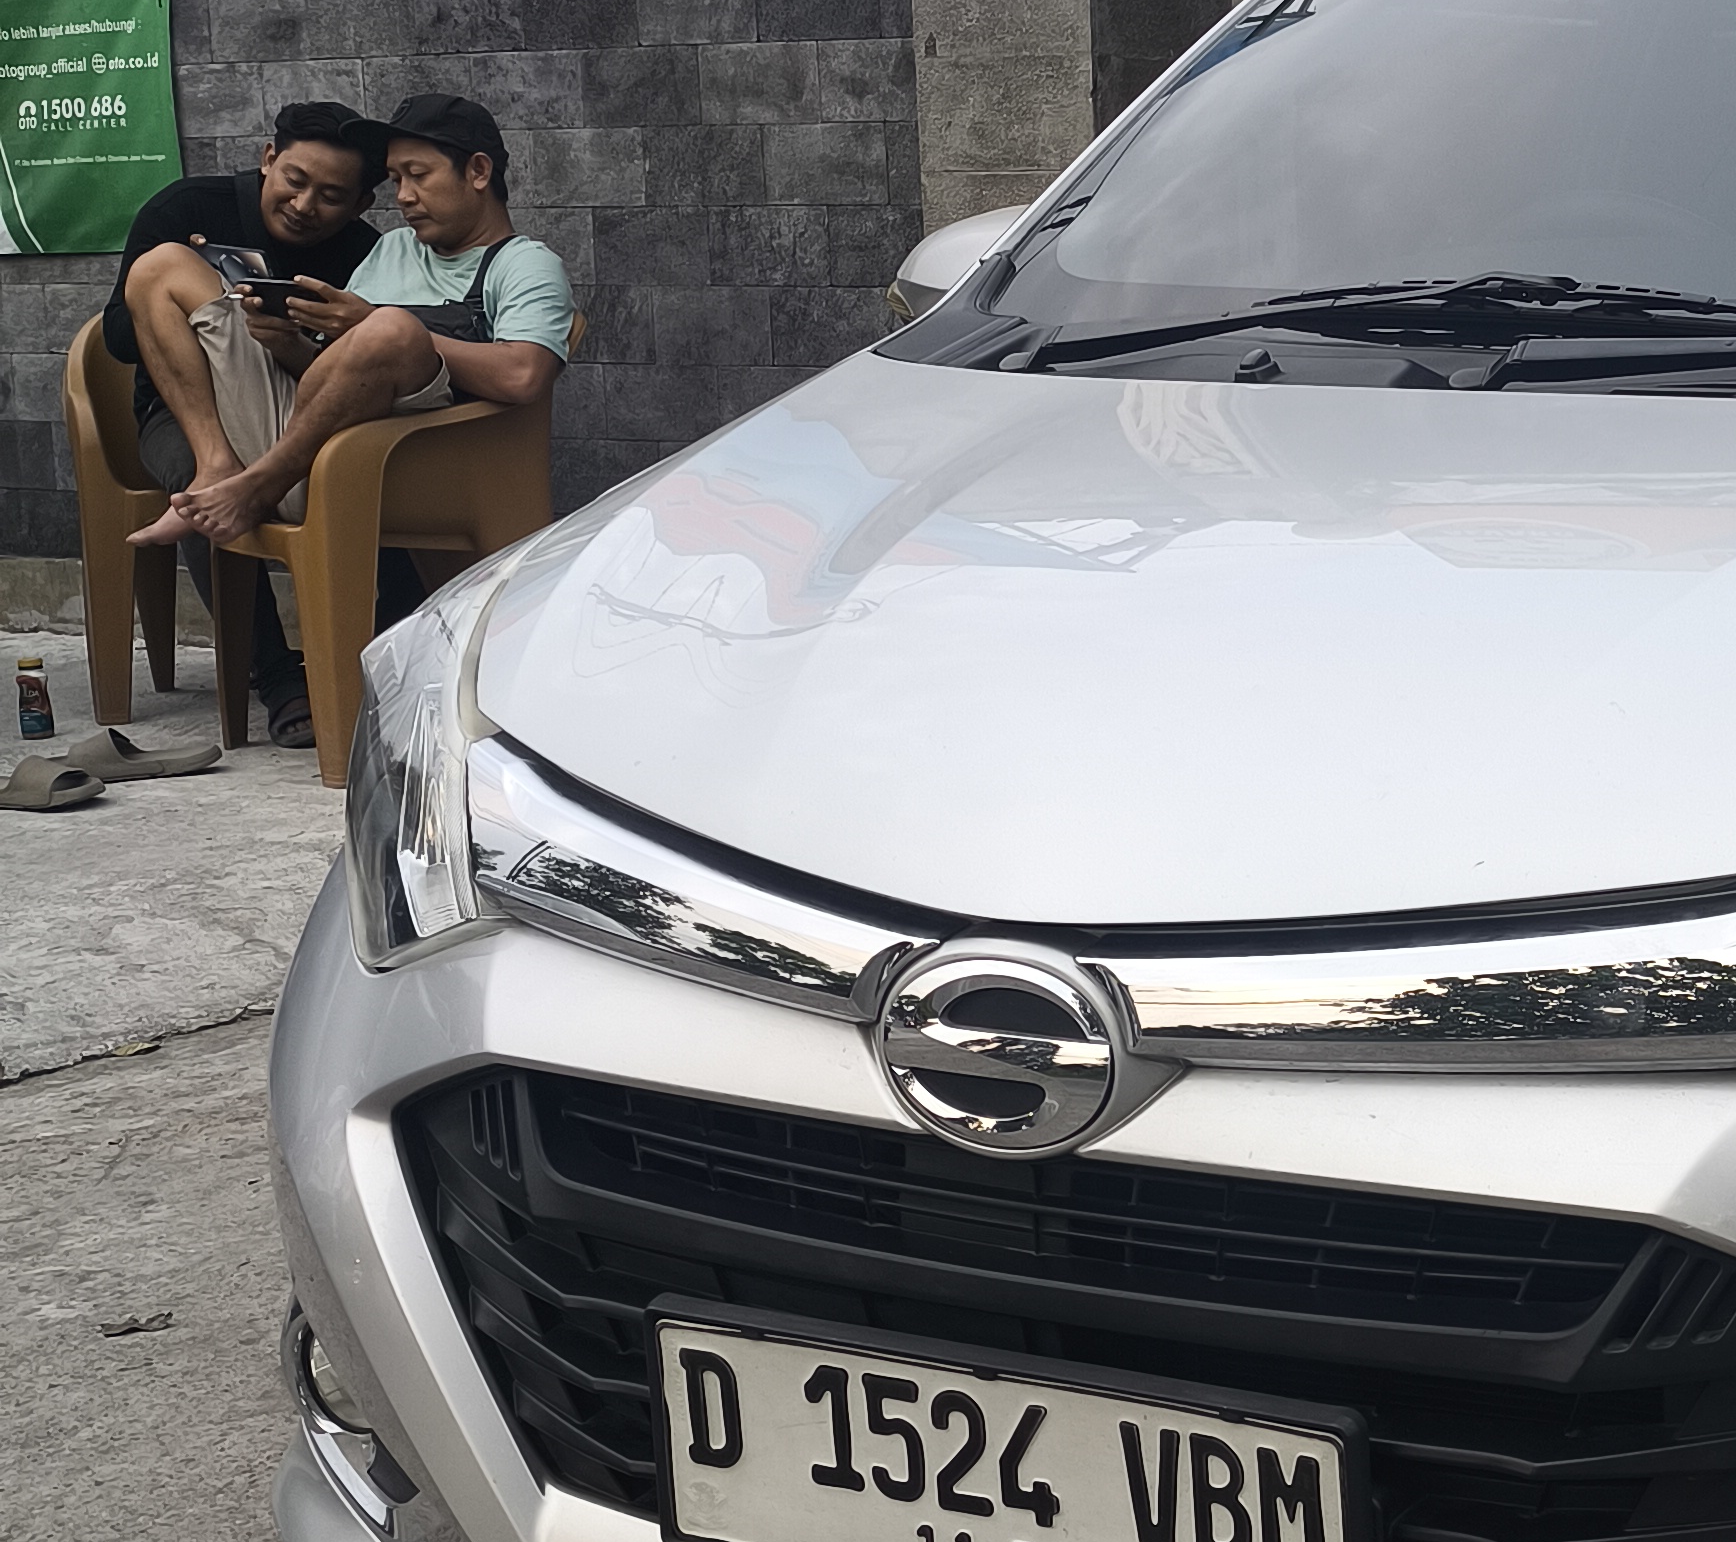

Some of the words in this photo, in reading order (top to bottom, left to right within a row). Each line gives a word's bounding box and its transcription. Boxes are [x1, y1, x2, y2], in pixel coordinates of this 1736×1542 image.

[11, 26, 38, 40] lebih
[65, 17, 136, 35] akses/hubungi
[41, 99, 86, 120] 1500
[91, 94, 127, 116] 686
[18, 116, 37, 130] OTO
[42, 122, 73, 132] CALL
[78, 117, 127, 131] CENTER
[679, 1347, 744, 1469] D
[803, 1364, 1061, 1528] 1524
